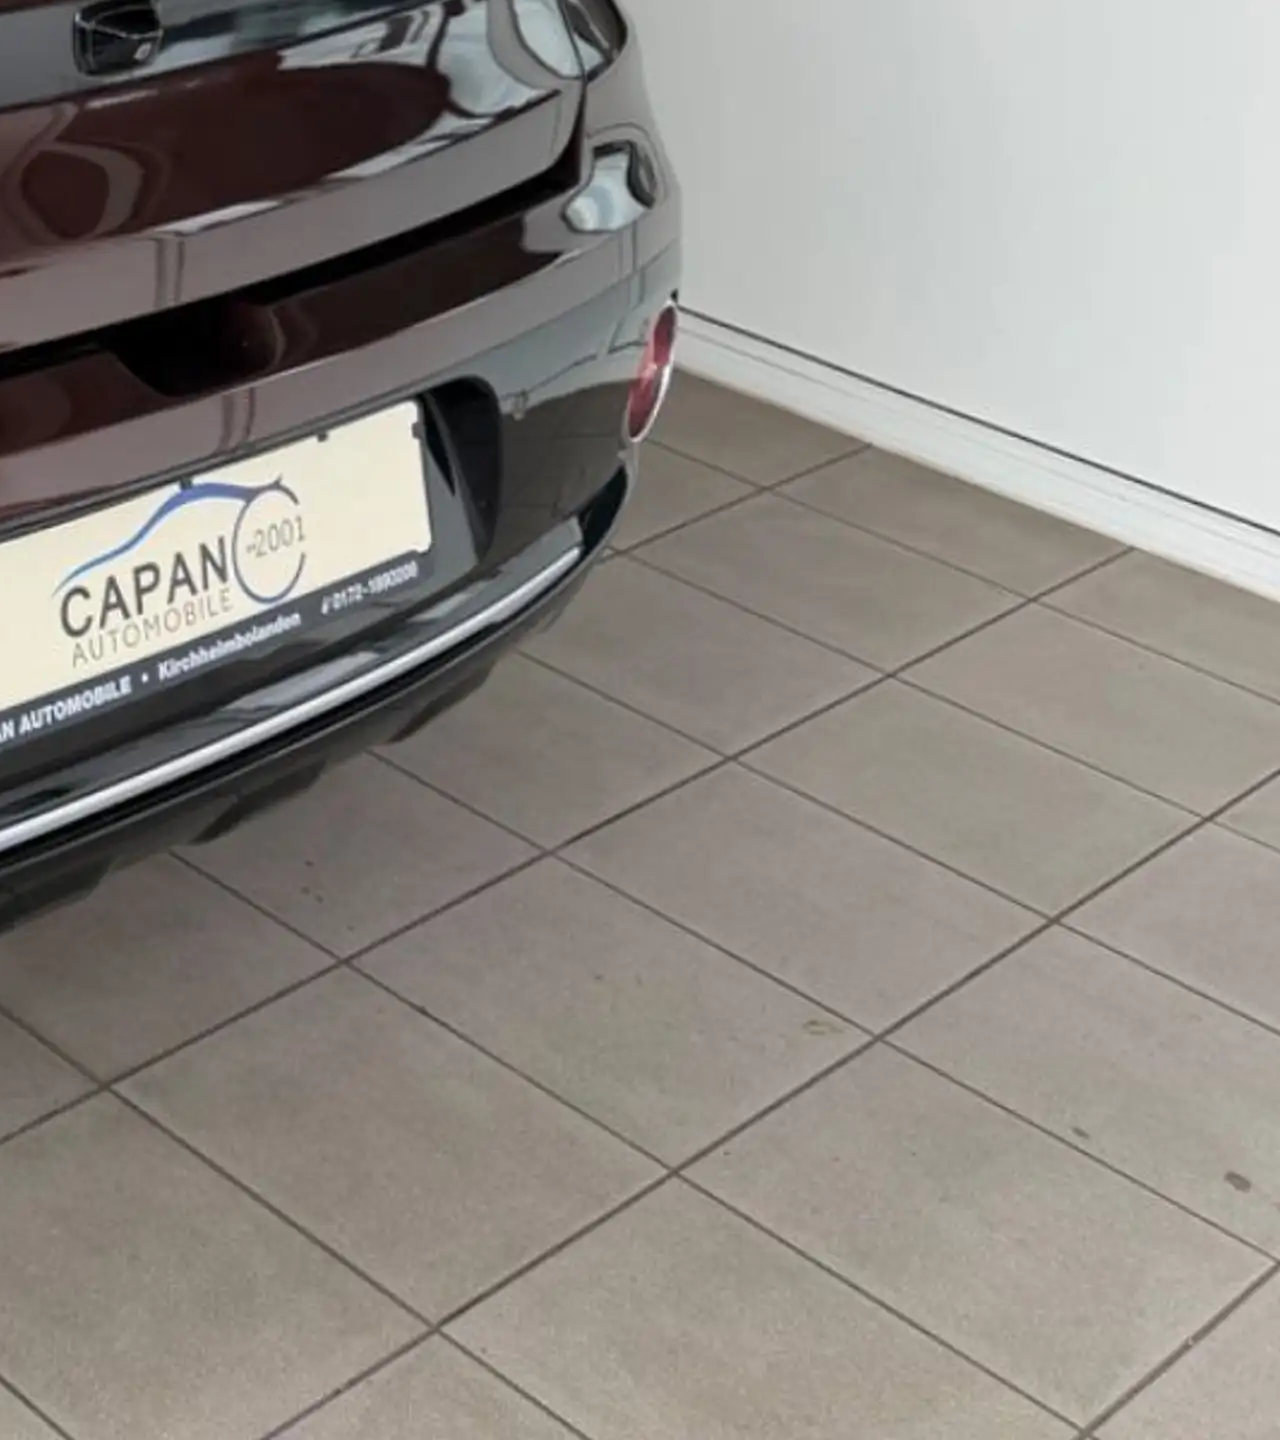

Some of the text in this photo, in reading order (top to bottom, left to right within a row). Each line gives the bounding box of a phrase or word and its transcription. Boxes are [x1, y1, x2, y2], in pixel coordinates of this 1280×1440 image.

[253, 515, 307, 558] 2001
[59, 535, 229, 638] CAPAN
[71, 587, 235, 669] AUTOMOBILE
[19, 674, 132, 736] AUTOMOBILE
